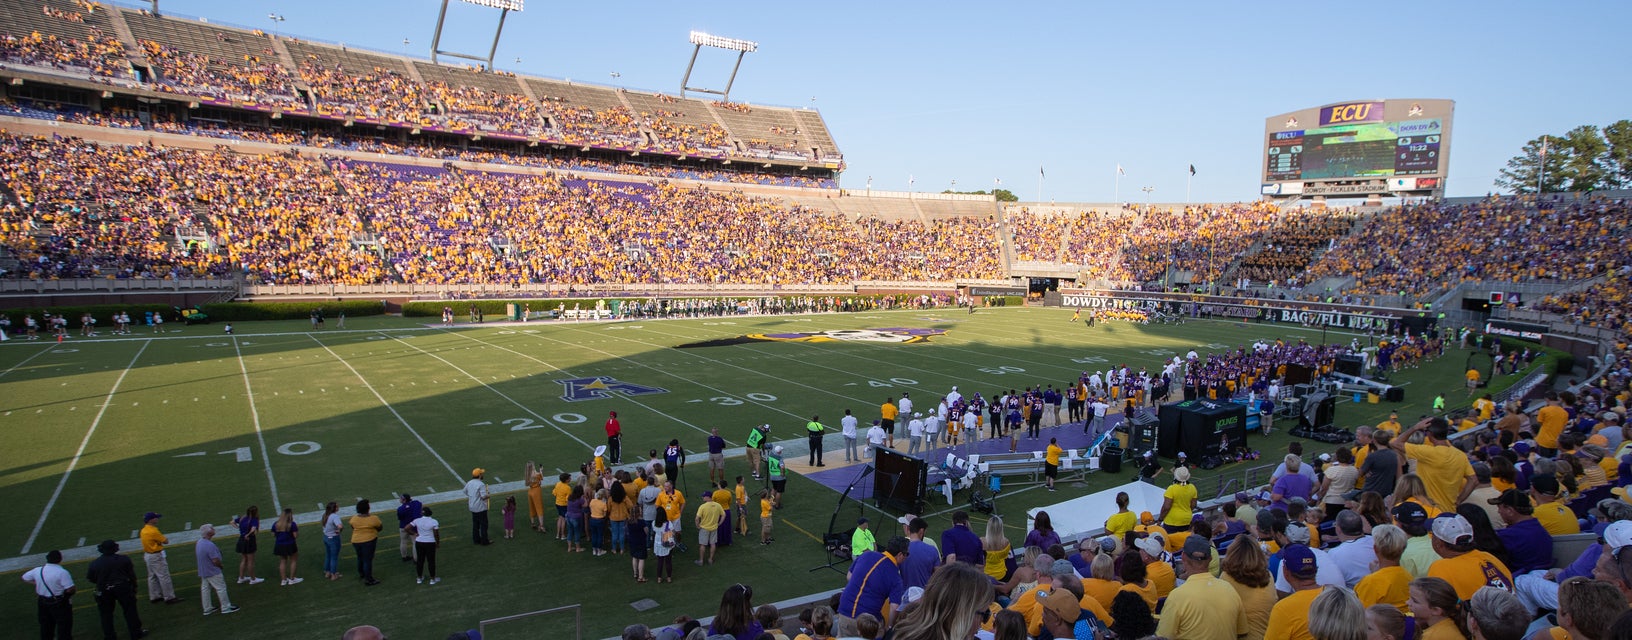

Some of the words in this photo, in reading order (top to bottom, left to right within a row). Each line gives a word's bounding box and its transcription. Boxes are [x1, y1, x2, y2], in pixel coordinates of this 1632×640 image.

[1330, 104, 1372, 123] ECU
[1358, 182, 1385, 191] STADIUM
[868, 377, 919, 388] 40
[709, 393, 778, 406] 30
[992, 405, 1001, 413] 26
[951, 411, 960, 420] 51
[502, 413, 588, 431] 20
[666, 447, 678, 456] 45
